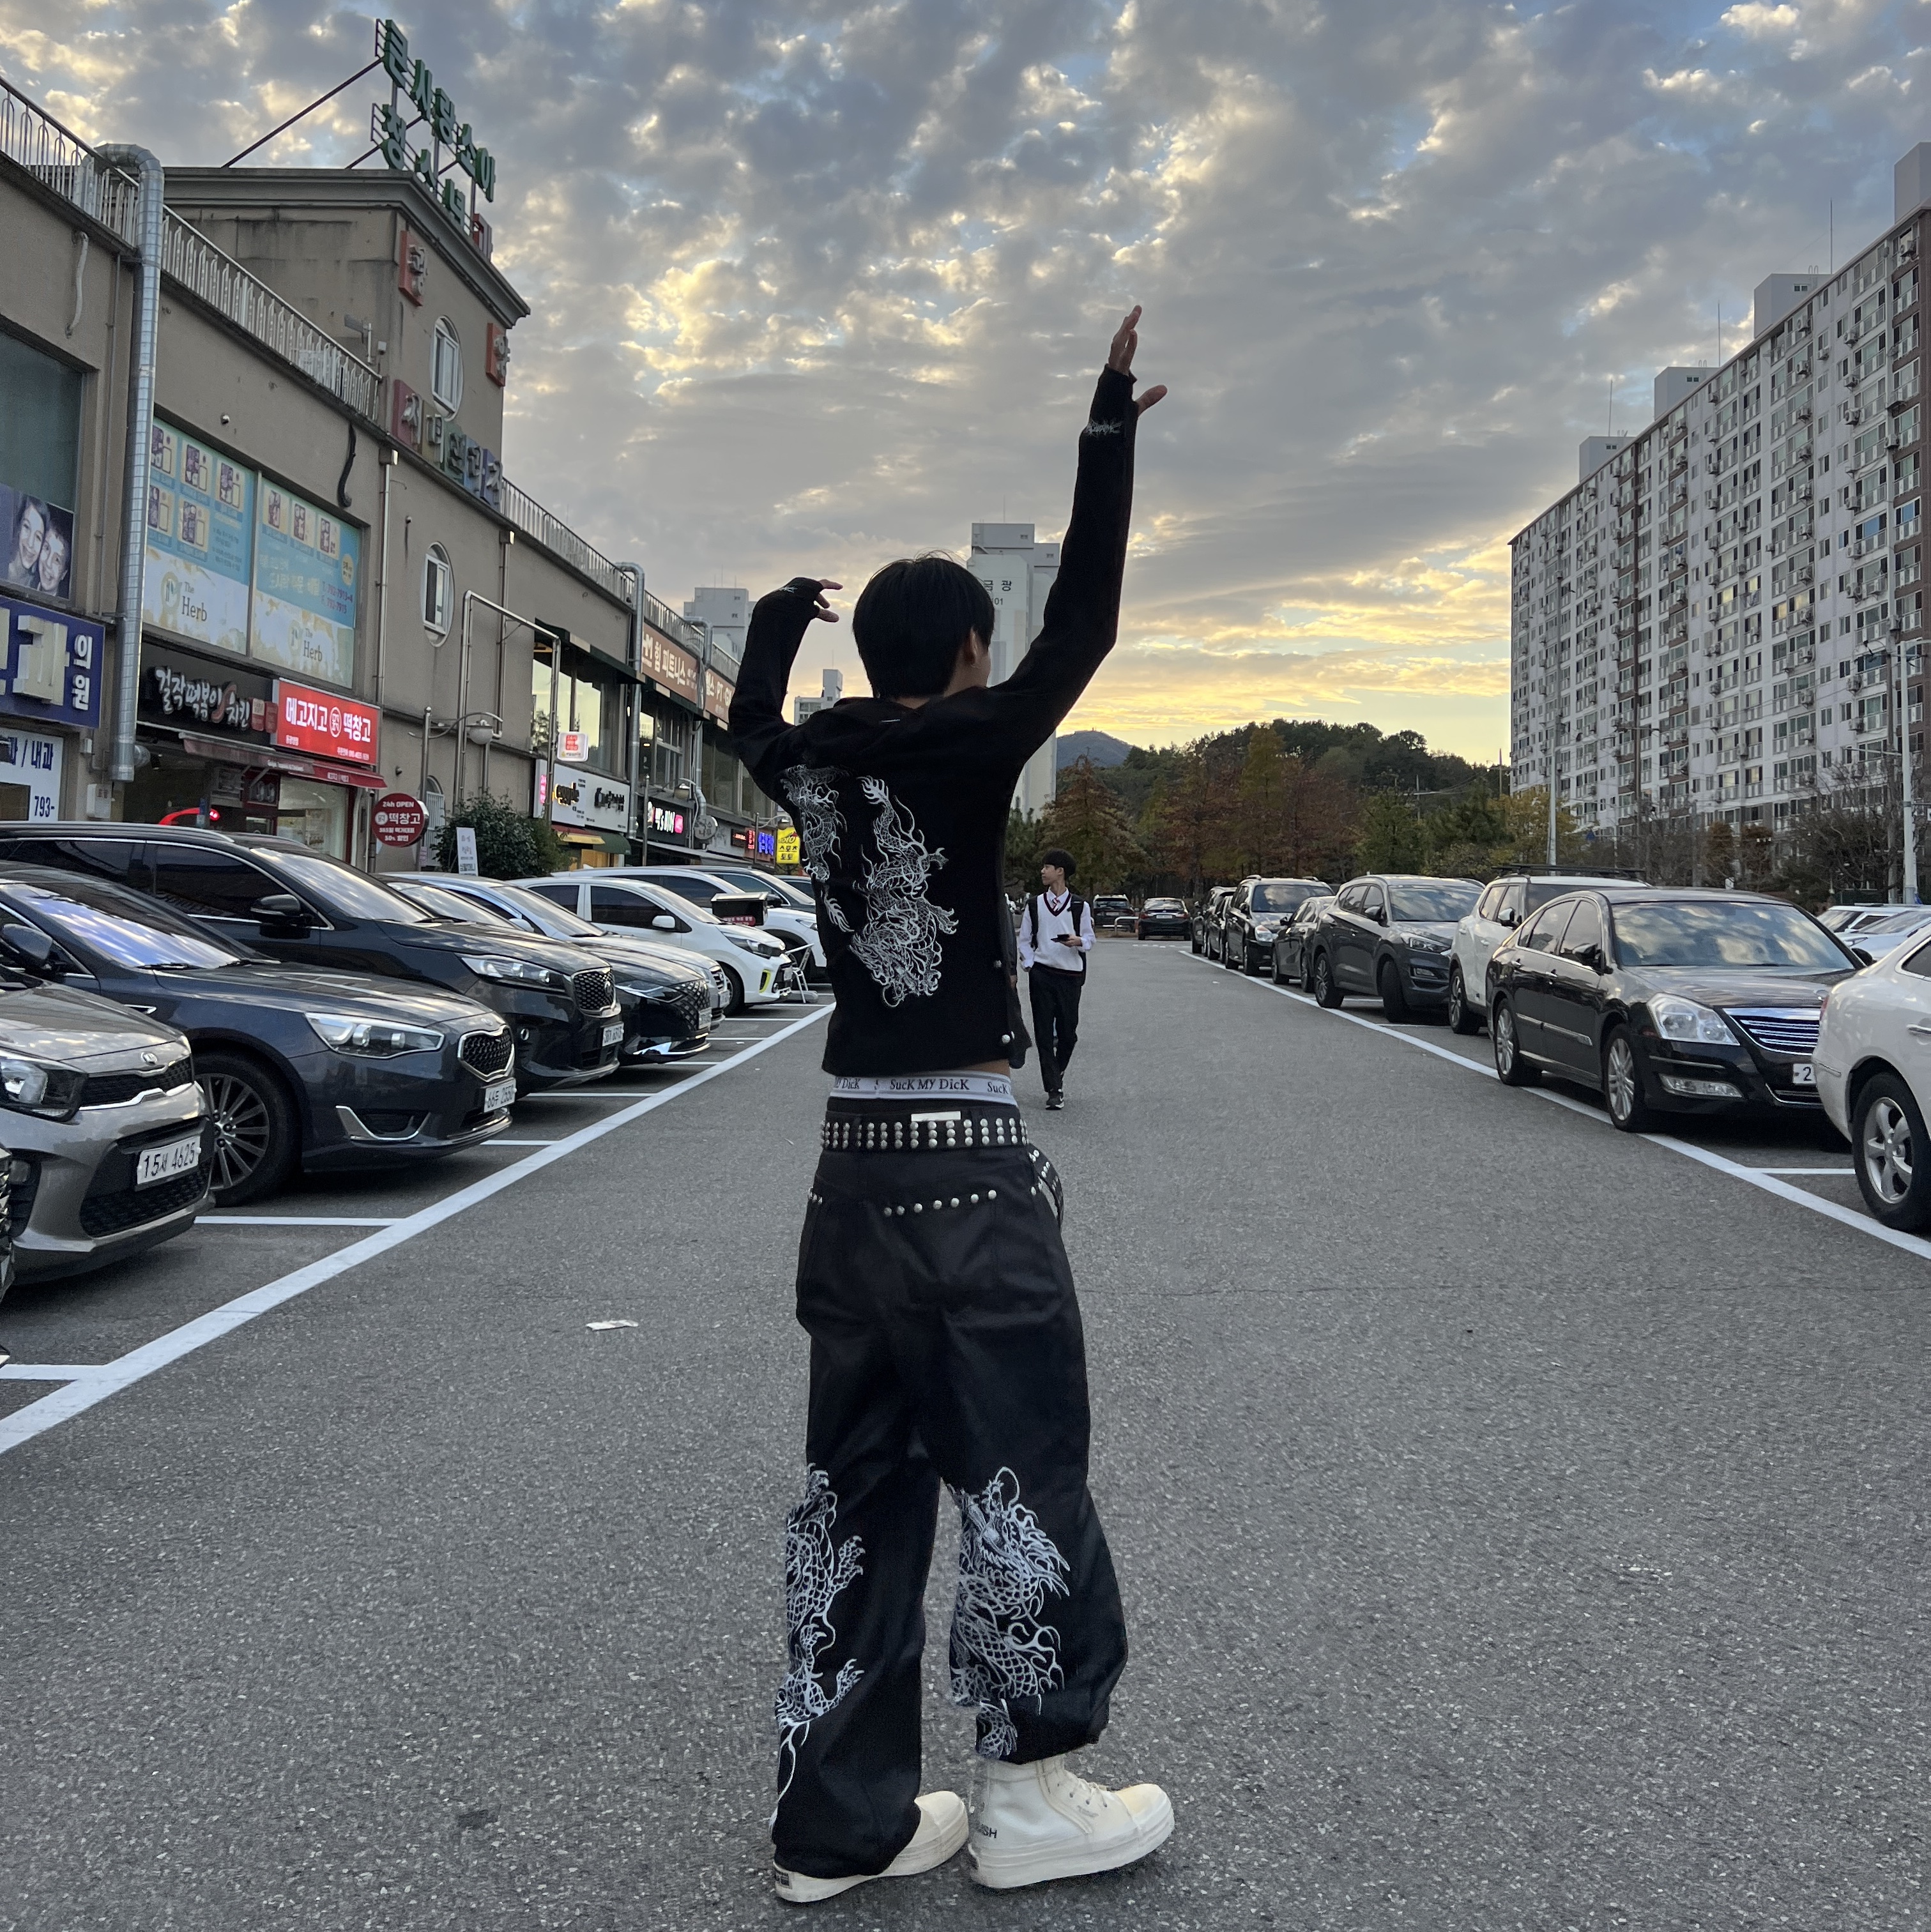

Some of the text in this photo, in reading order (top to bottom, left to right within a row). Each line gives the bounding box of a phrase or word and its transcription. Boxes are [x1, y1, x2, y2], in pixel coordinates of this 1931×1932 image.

[383, 19, 496, 203] 큰사랑소아
[184, 581, 194, 594] The
[181, 595, 208, 622] Herb
[305, 627, 314, 639] The
[303, 639, 323, 662] Herb
[72, 635, 93, 711] 의원
[662, 649, 686, 686] 피트니스
[155, 667, 222, 719] 걸작떡볶이
[226, 692, 251, 729] 치킨
[343, 712, 371, 743] 떡창고
[31, 740, 54, 771] 내과
[388, 812, 421, 825] 떡창고
[890, 1079, 915, 1090] SucK
[939, 1078, 970, 1090] DicK
[987, 1081, 1009, 1093] SucK
[171, 1141, 195, 1169] 4625
